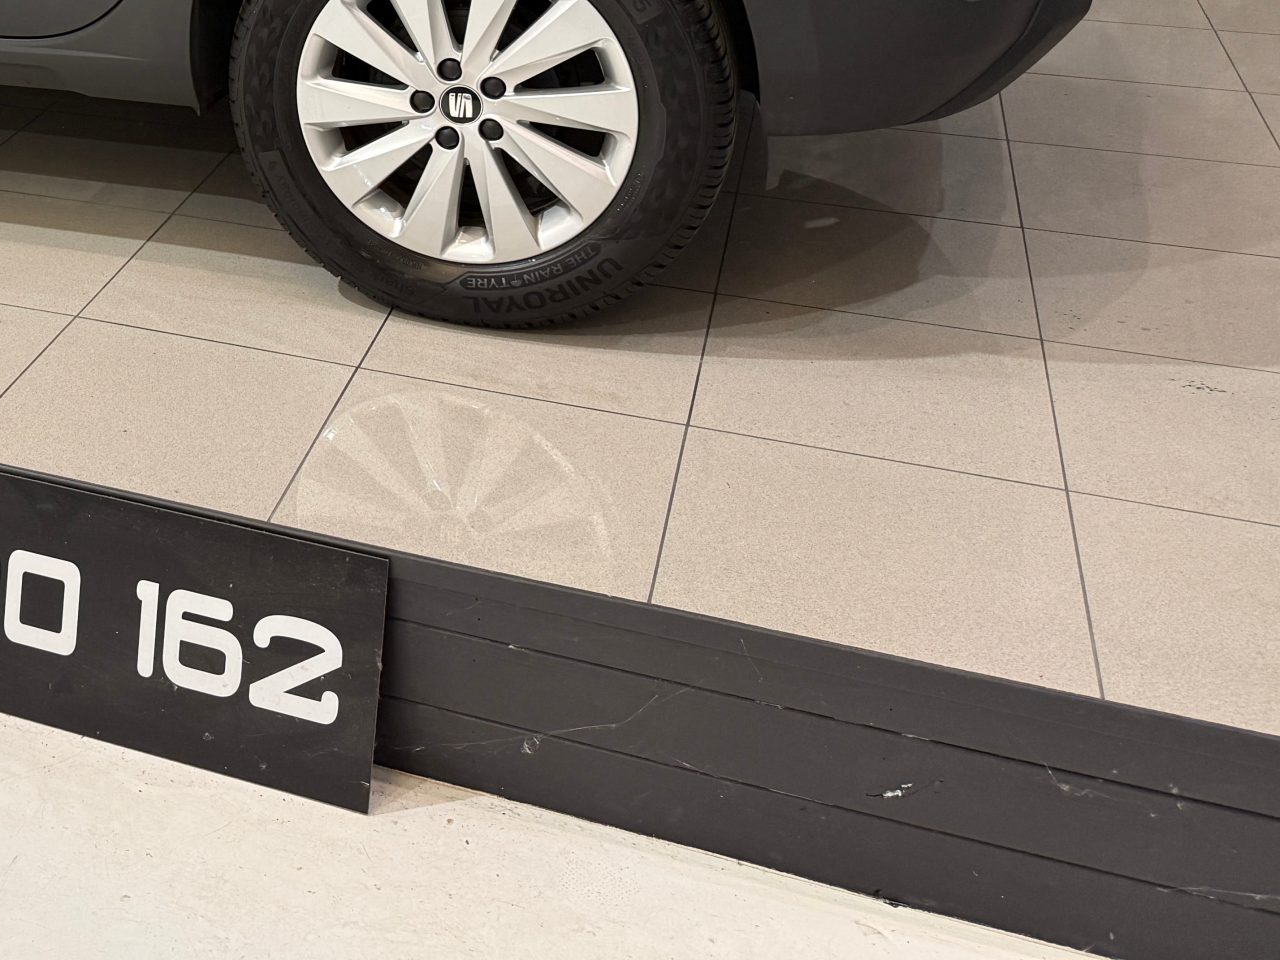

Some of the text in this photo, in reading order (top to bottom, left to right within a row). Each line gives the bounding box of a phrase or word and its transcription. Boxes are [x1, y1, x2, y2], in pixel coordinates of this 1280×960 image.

[462, 257, 624, 314] UNIROYAL
[466, 243, 596, 289] THE RAIN TYRE
[136, 579, 343, 725] 162
